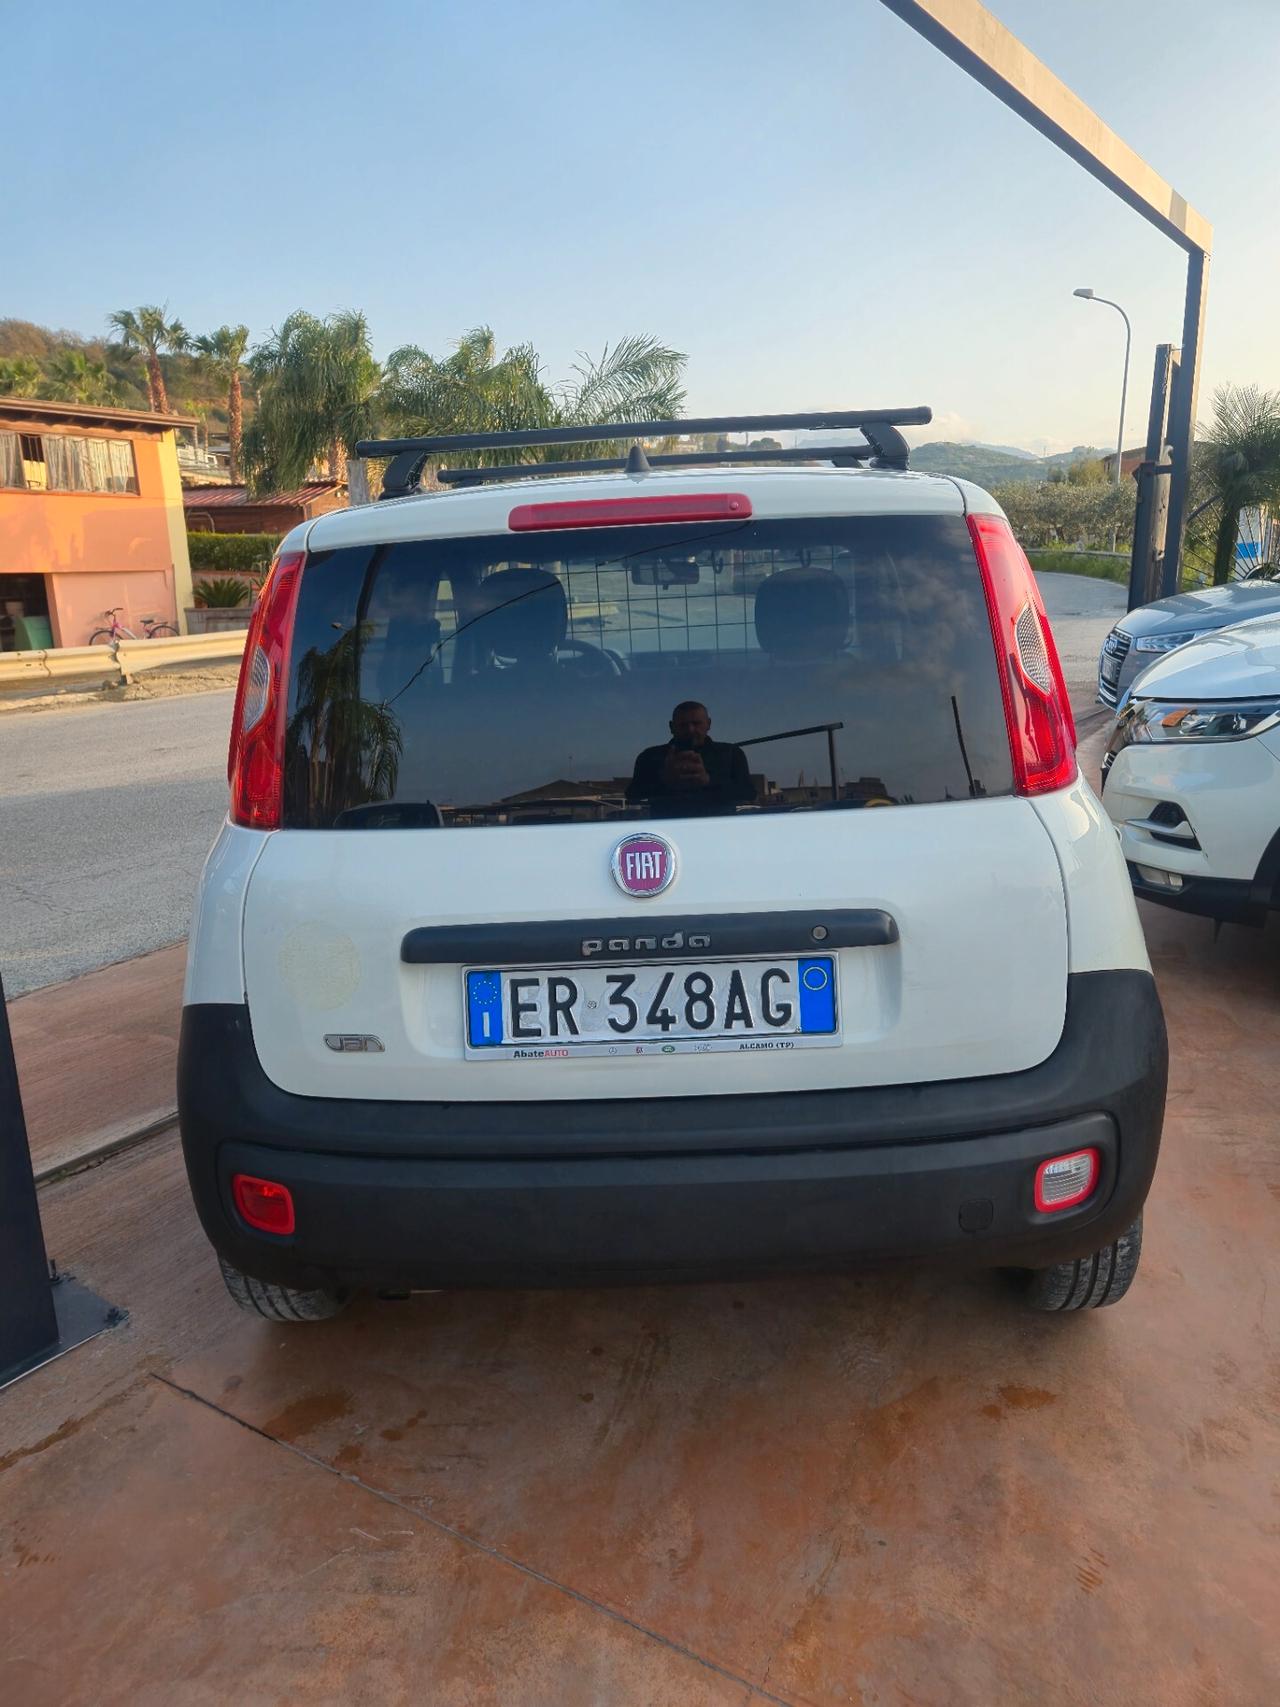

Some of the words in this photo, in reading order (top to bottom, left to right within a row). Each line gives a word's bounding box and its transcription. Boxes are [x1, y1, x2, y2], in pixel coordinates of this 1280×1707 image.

[626, 851, 662, 880] FIAT
[582, 932, 711, 956] panda
[510, 976, 580, 1038] ER
[606, 968, 792, 1033] 348AG
